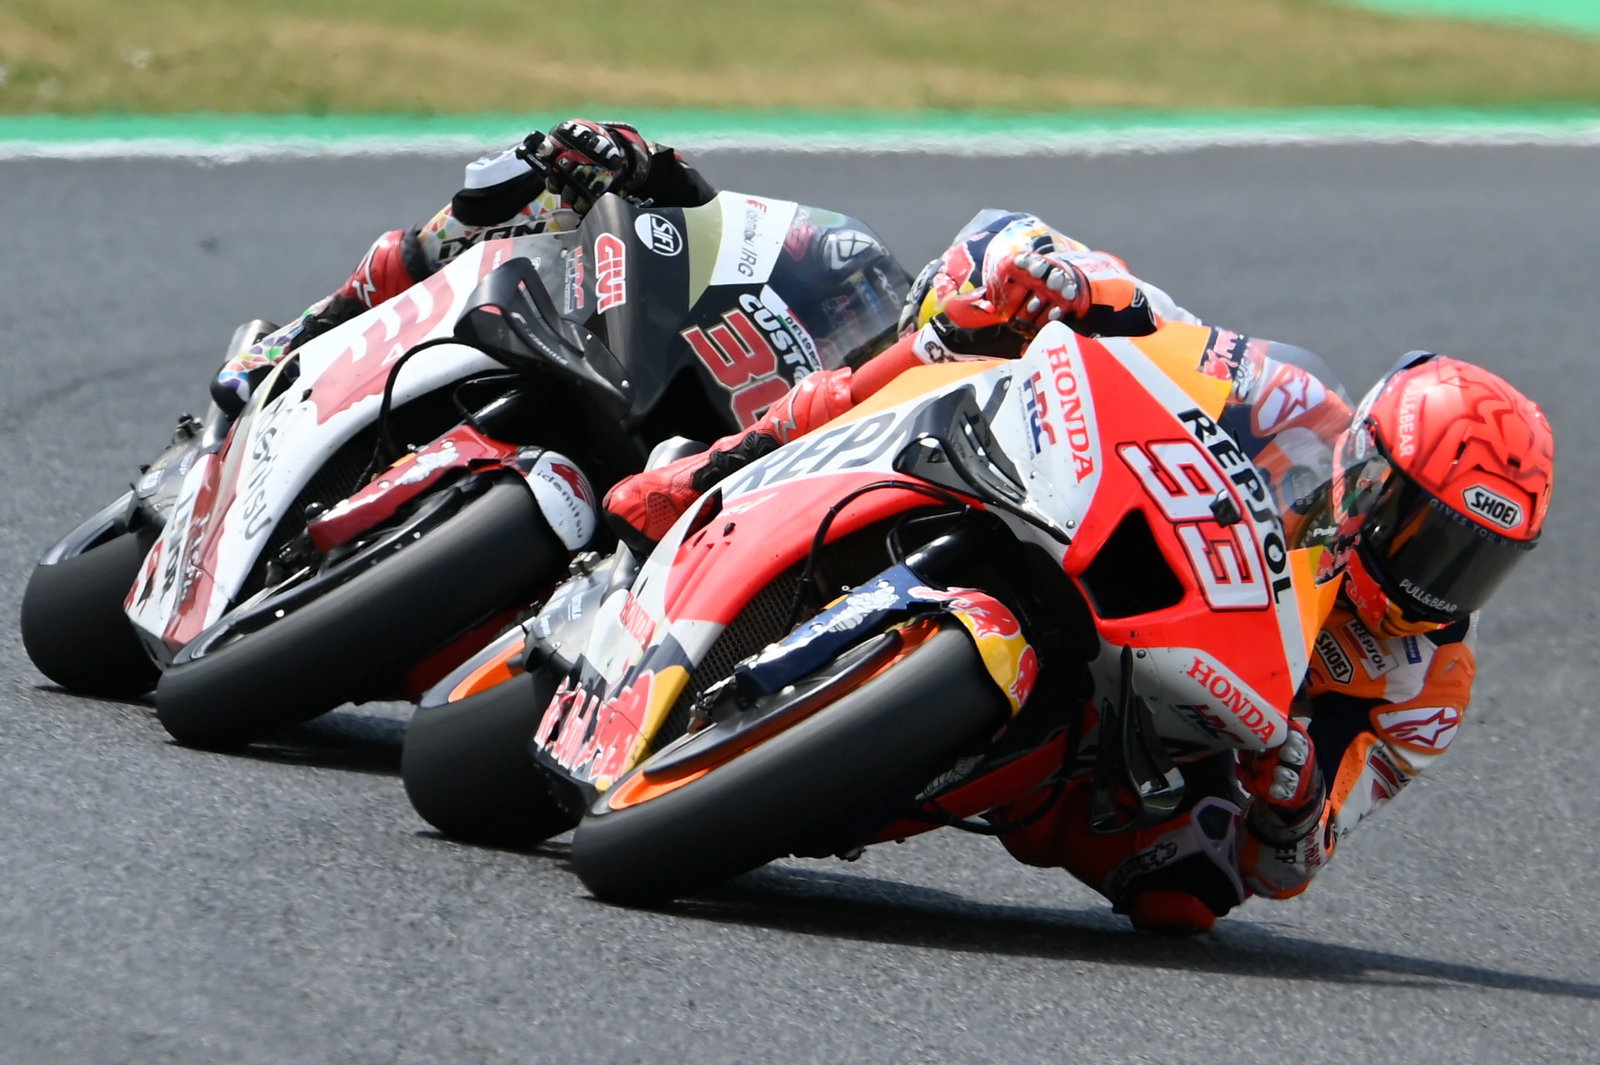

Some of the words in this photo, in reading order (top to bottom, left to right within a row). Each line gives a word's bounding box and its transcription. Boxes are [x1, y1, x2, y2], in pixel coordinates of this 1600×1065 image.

[594, 232, 627, 315] GIVI
[738, 245, 760, 277] IRG
[722, 396, 939, 500] REPS
[1023, 371, 1056, 454] HRC
[1046, 344, 1095, 484] HONDA
[1114, 438, 1271, 612] 93
[1177, 408, 1291, 604] REPSOL
[1430, 498, 1468, 525] GIVES
[1470, 491, 1518, 525] SHOEI
[1399, 578, 1458, 613] PULL&BEAR
[1317, 632, 1349, 678] SHOEI
[1350, 621, 1386, 671] REPSOL
[1186, 656, 1276, 745] HONDA
